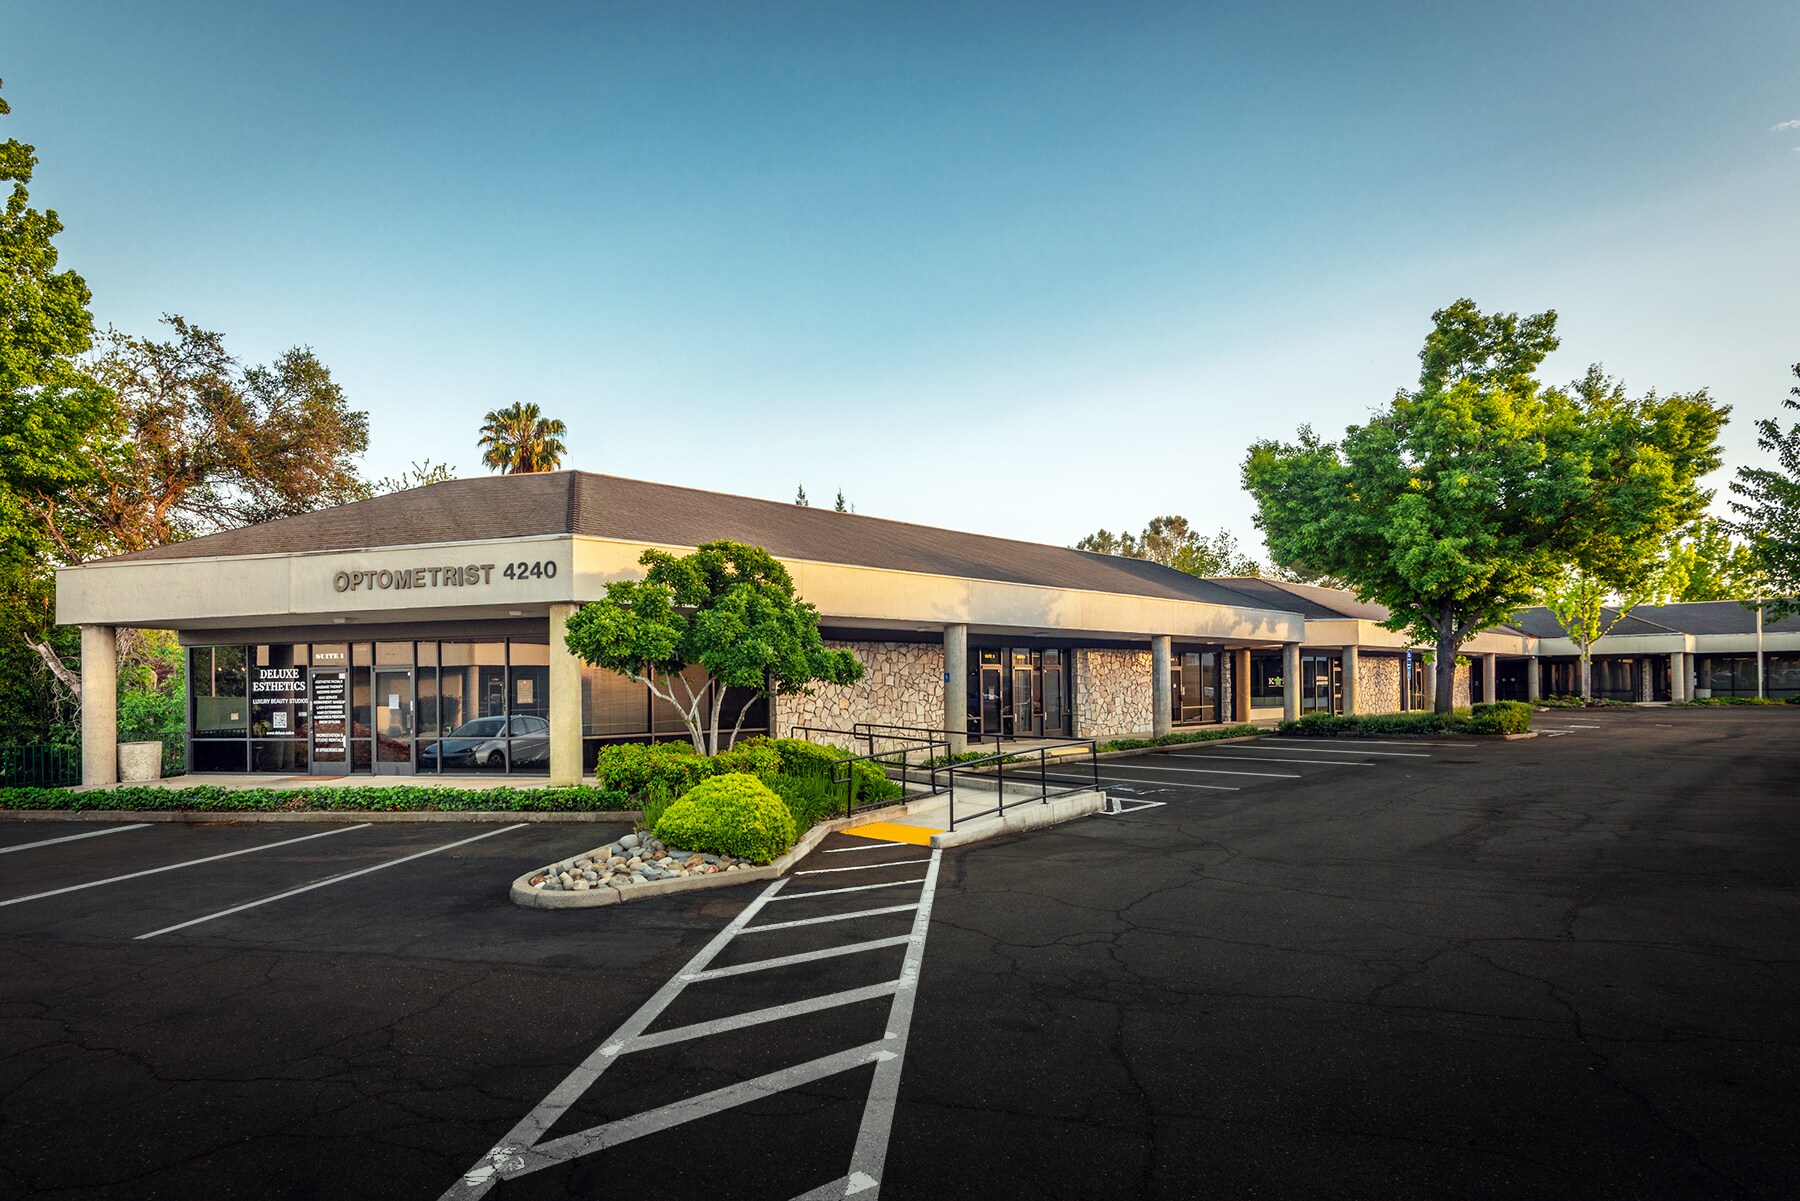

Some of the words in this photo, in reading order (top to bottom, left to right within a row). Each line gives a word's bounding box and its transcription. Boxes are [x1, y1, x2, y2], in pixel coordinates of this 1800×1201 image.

[333, 564, 495, 592] OPTOMETRIST
[503, 560, 557, 580] 4240
[260, 668, 300, 679] DELUXE
[252, 681, 306, 691] ESTHETICS
